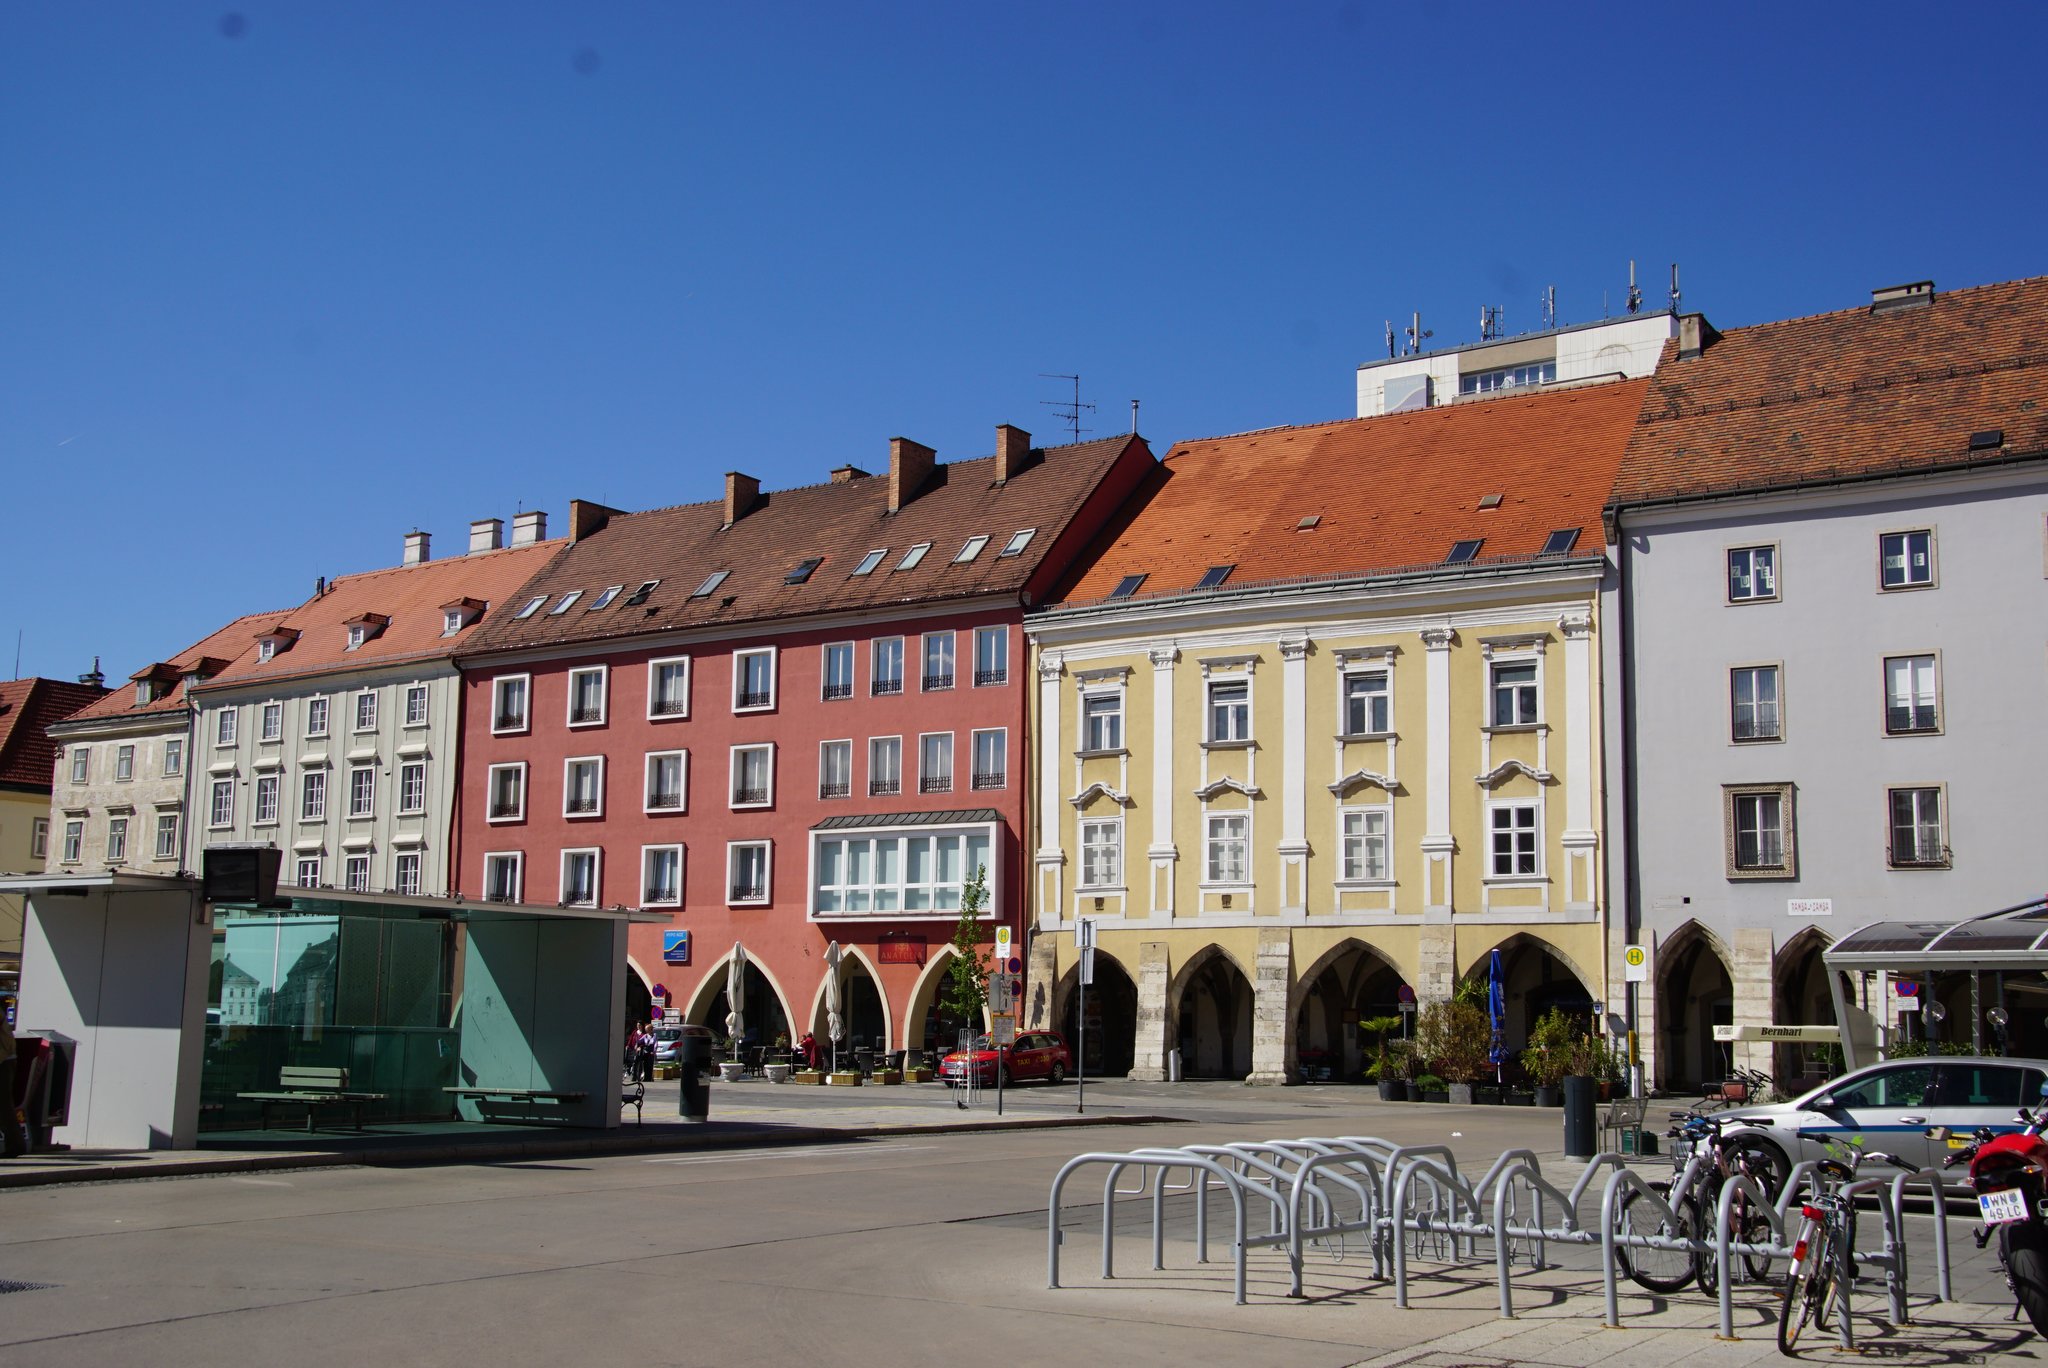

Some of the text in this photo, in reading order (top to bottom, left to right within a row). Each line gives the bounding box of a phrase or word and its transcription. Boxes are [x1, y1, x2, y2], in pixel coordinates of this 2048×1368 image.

[880, 951, 923, 961] ANATOLIA
[1630, 951, 1640, 963] H
[1760, 1027, 1802, 1037] Bernhart
[1990, 1193, 2008, 1207] WN
[1990, 1205, 2021, 1220] 49 LC
